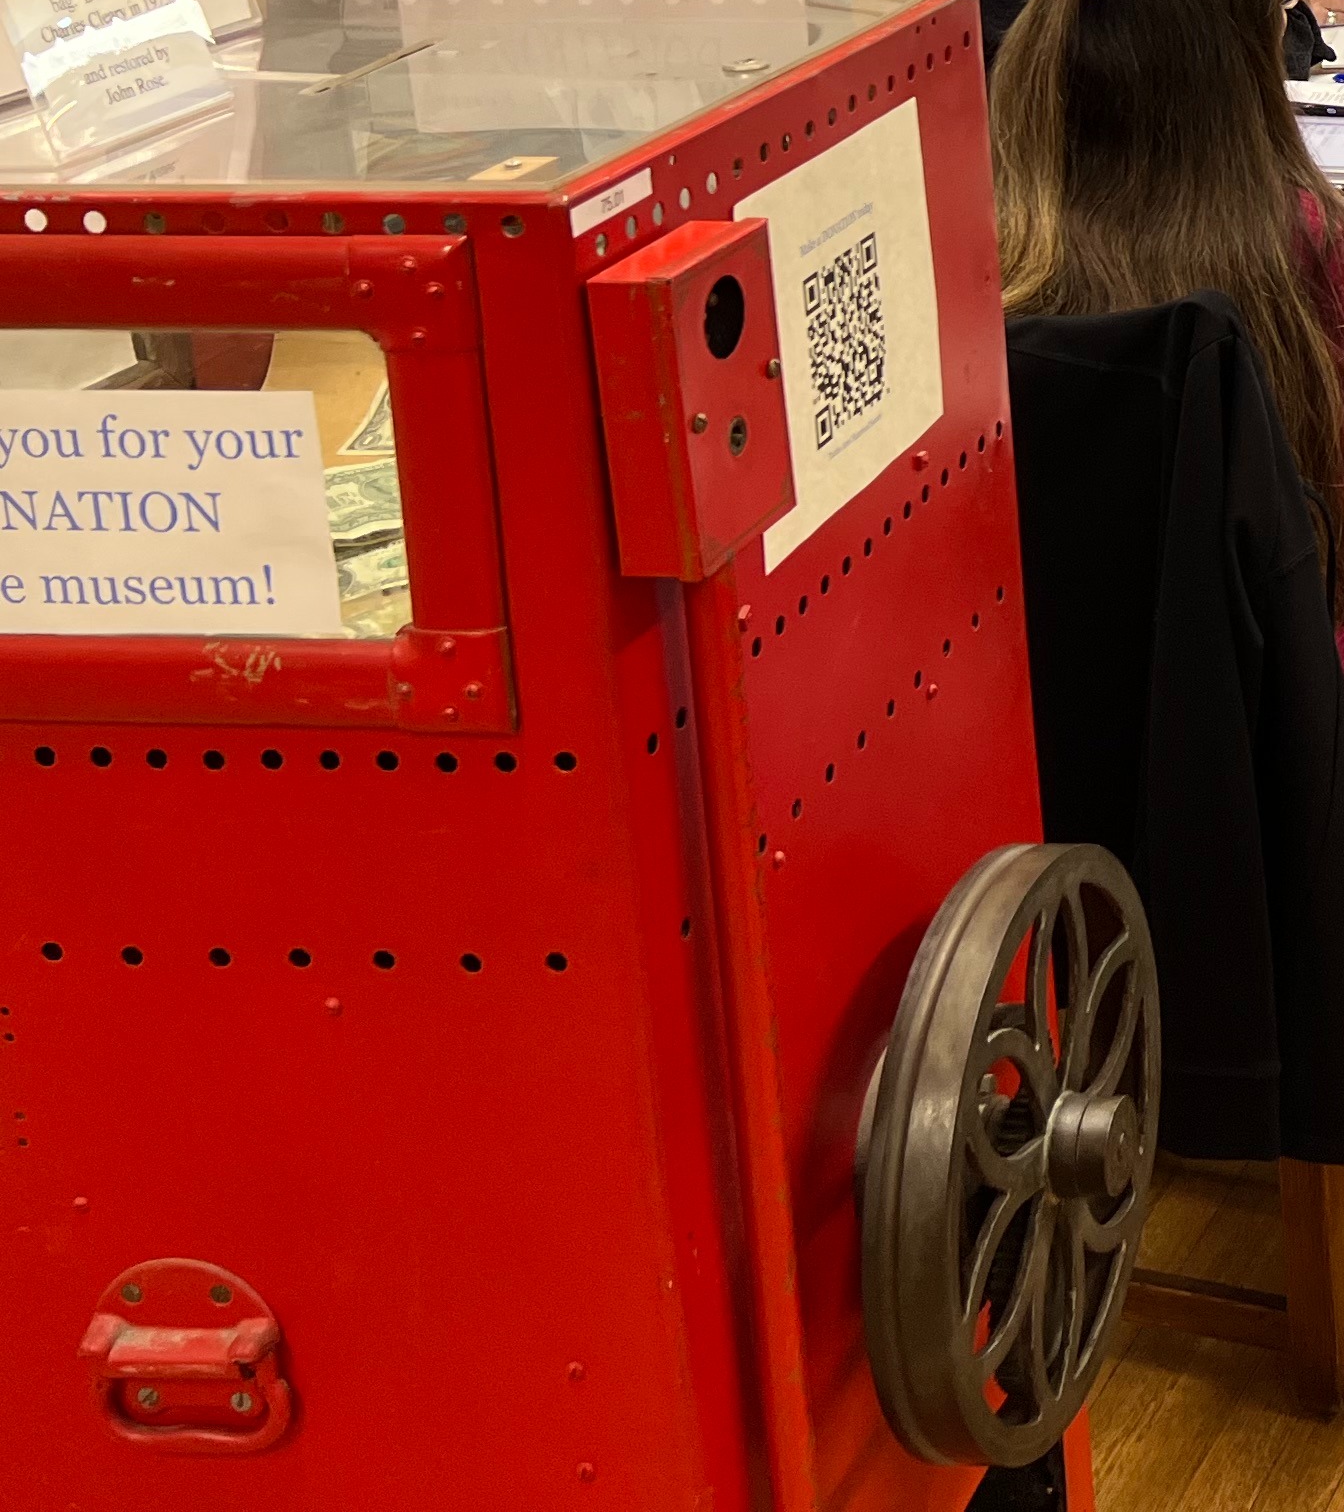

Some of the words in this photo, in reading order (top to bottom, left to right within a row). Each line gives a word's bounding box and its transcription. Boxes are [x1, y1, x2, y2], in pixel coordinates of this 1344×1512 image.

[84, 64, 108, 85] and
[109, 49, 155, 77] restored
[155, 46, 171, 64] by
[105, 83, 136, 106] John
[101, 414, 170, 459] for
[182, 426, 304, 471] your
[39, 563, 278, 606] museum!
